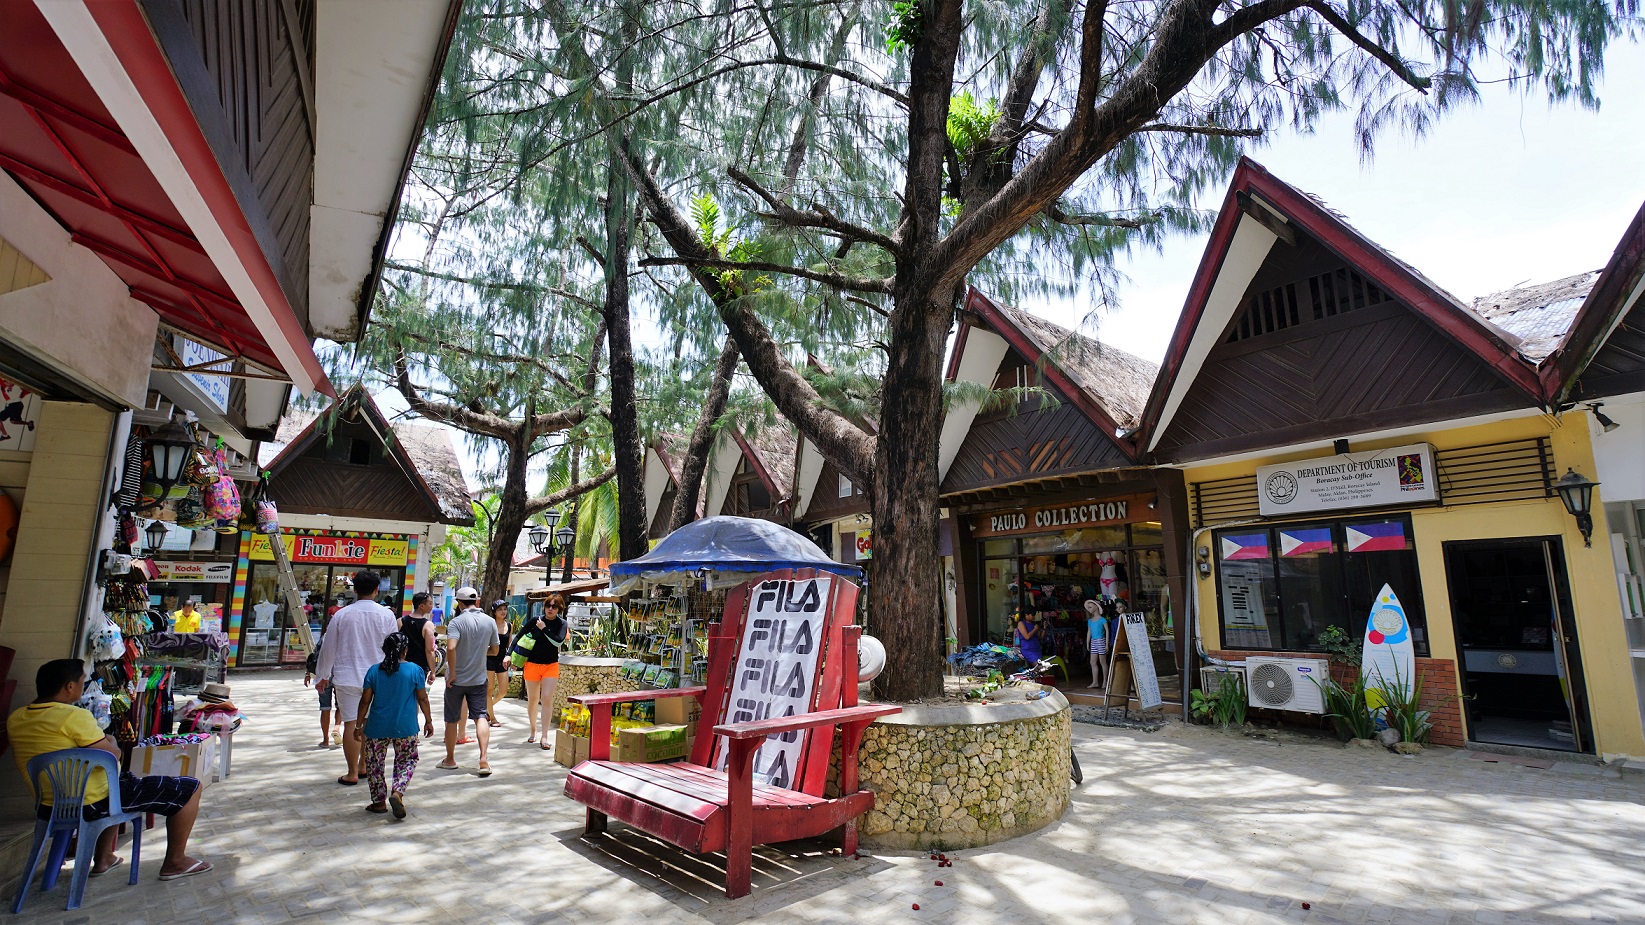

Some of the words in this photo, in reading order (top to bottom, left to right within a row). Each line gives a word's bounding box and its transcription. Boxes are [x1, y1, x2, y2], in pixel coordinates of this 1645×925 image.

[1297, 464, 1346, 479] DEPARTMENT
[1347, 462, 1358, 473] OF
[1359, 458, 1396, 471] TOURISM
[1316, 476, 1340, 484] Boracay
[1341, 472, 1373, 481] Sub-Office
[990, 513, 1026, 532] PAULO
[1035, 501, 1127, 528] COLLECTION
[252, 540, 293, 551] Fie!
[297, 537, 366, 559] Funkie
[370, 546, 406, 557] Fiesta!
[757, 579, 820, 613] FILA
[748, 619, 814, 655] FILA
[740, 658, 806, 699] FILA
